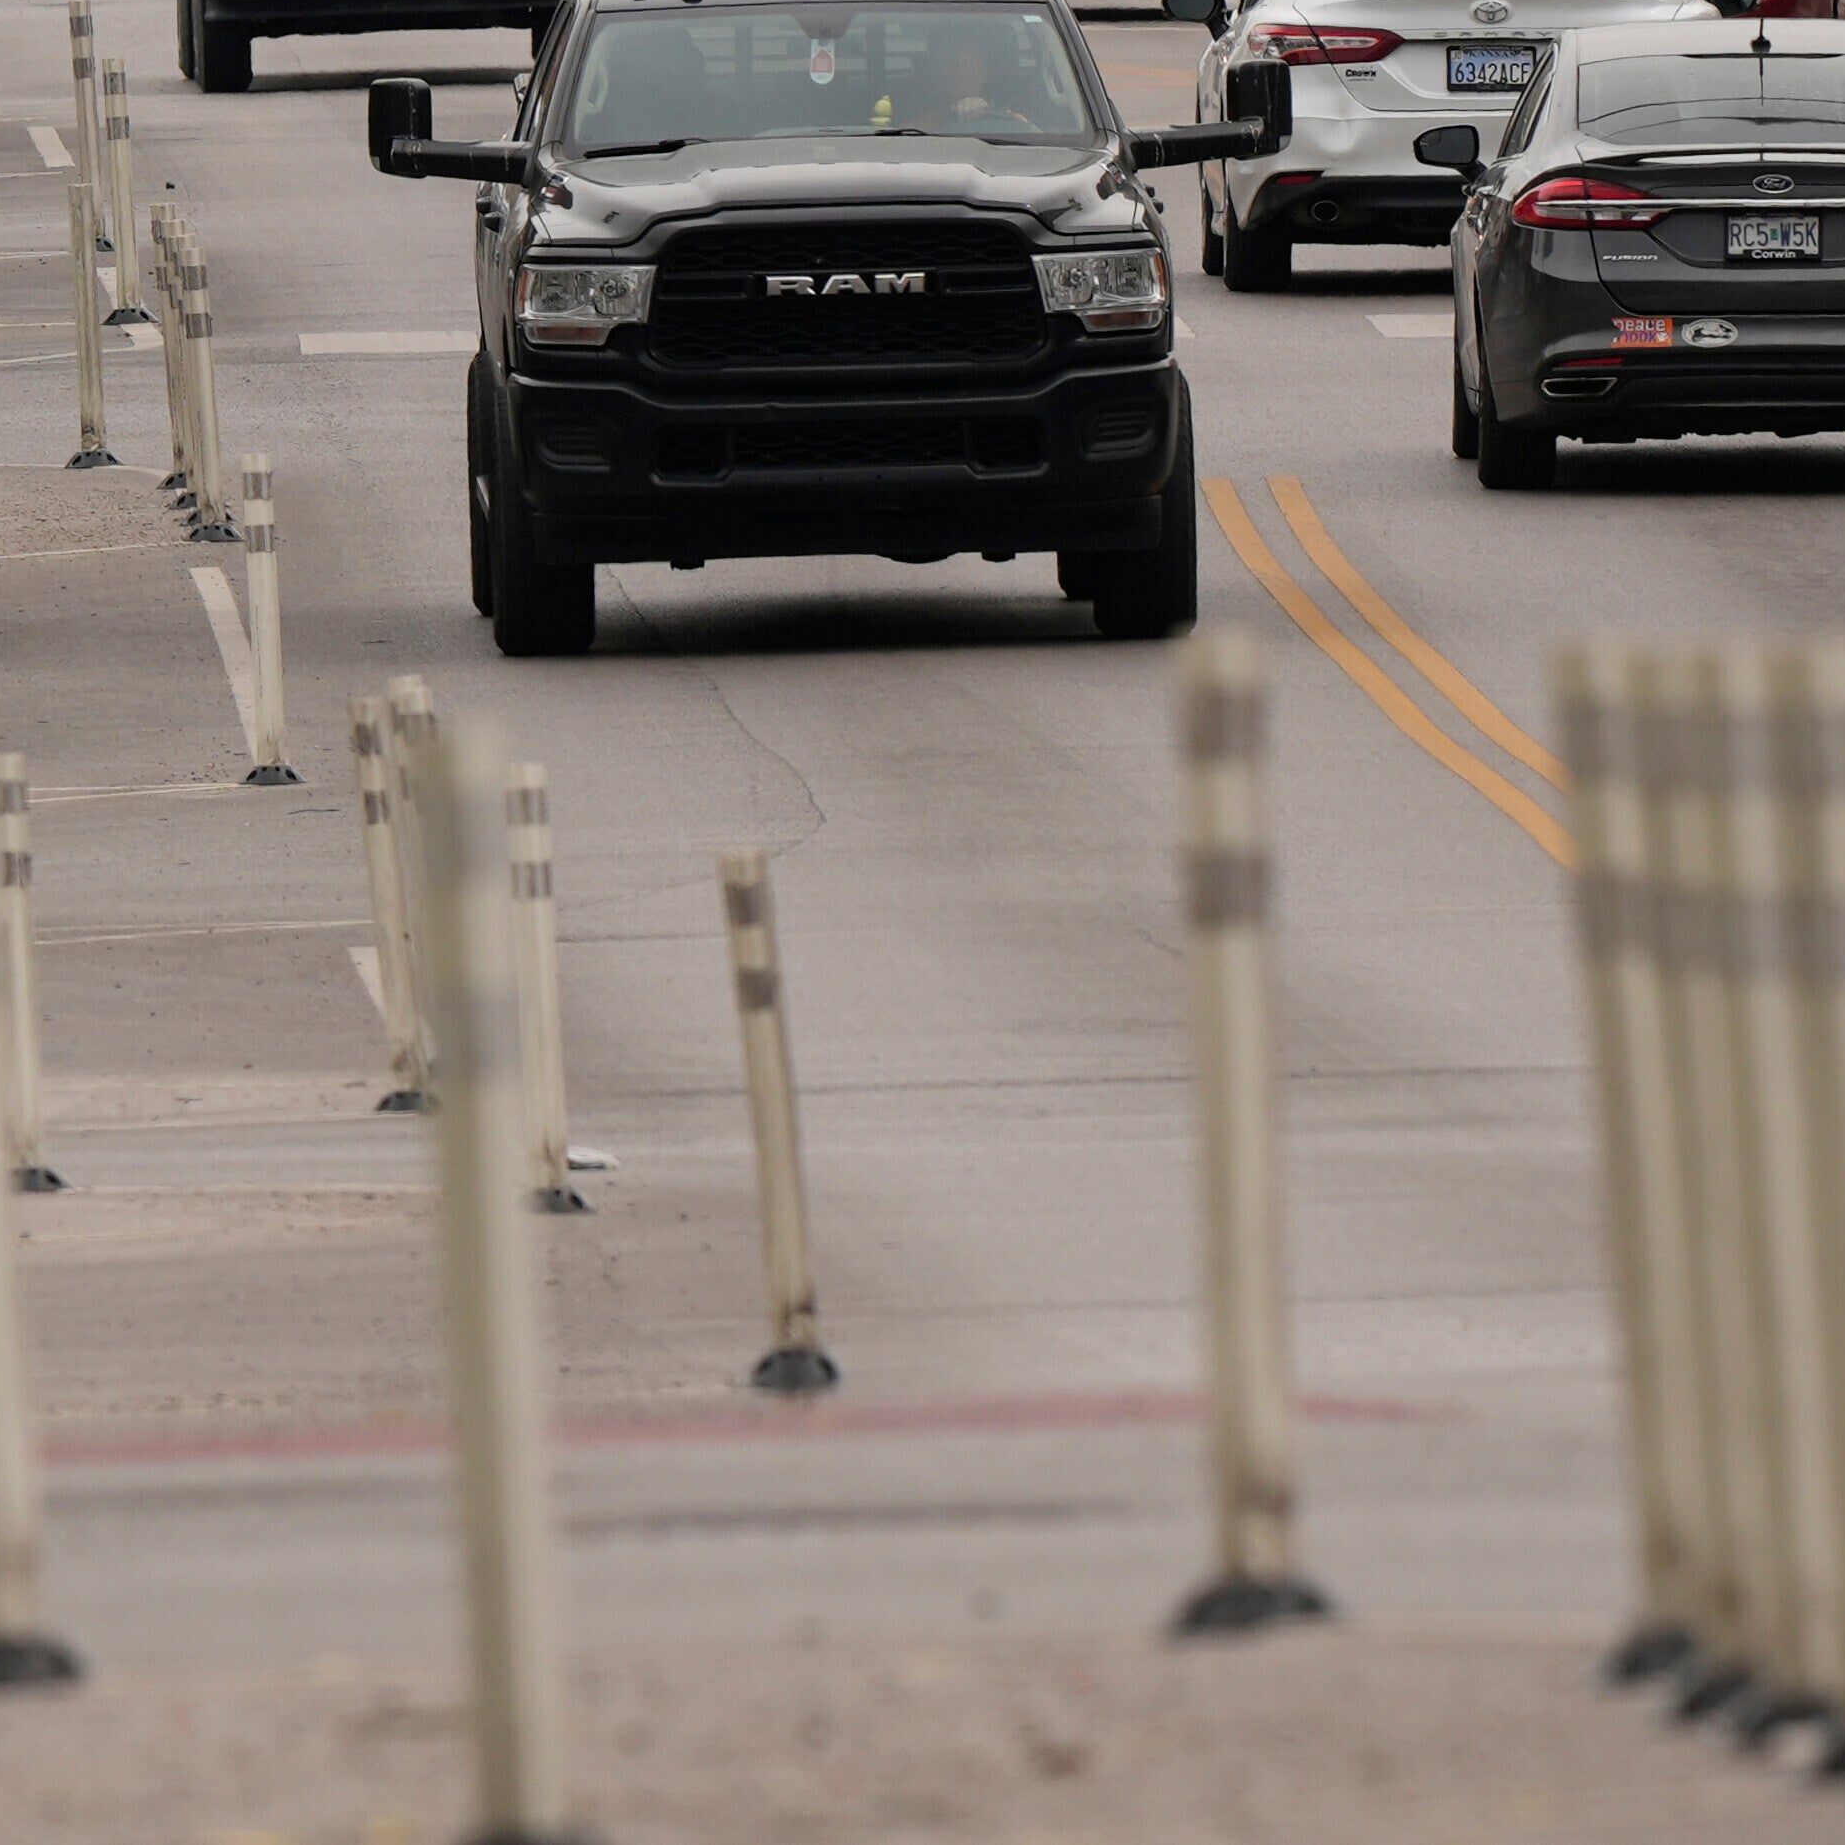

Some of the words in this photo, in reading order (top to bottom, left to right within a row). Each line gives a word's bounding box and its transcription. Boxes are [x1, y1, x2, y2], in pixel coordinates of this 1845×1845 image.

[1455, 62, 1533, 84] 6342ACF
[1751, 249, 1797, 259] Corwin
[765, 272, 926, 296] RAM
